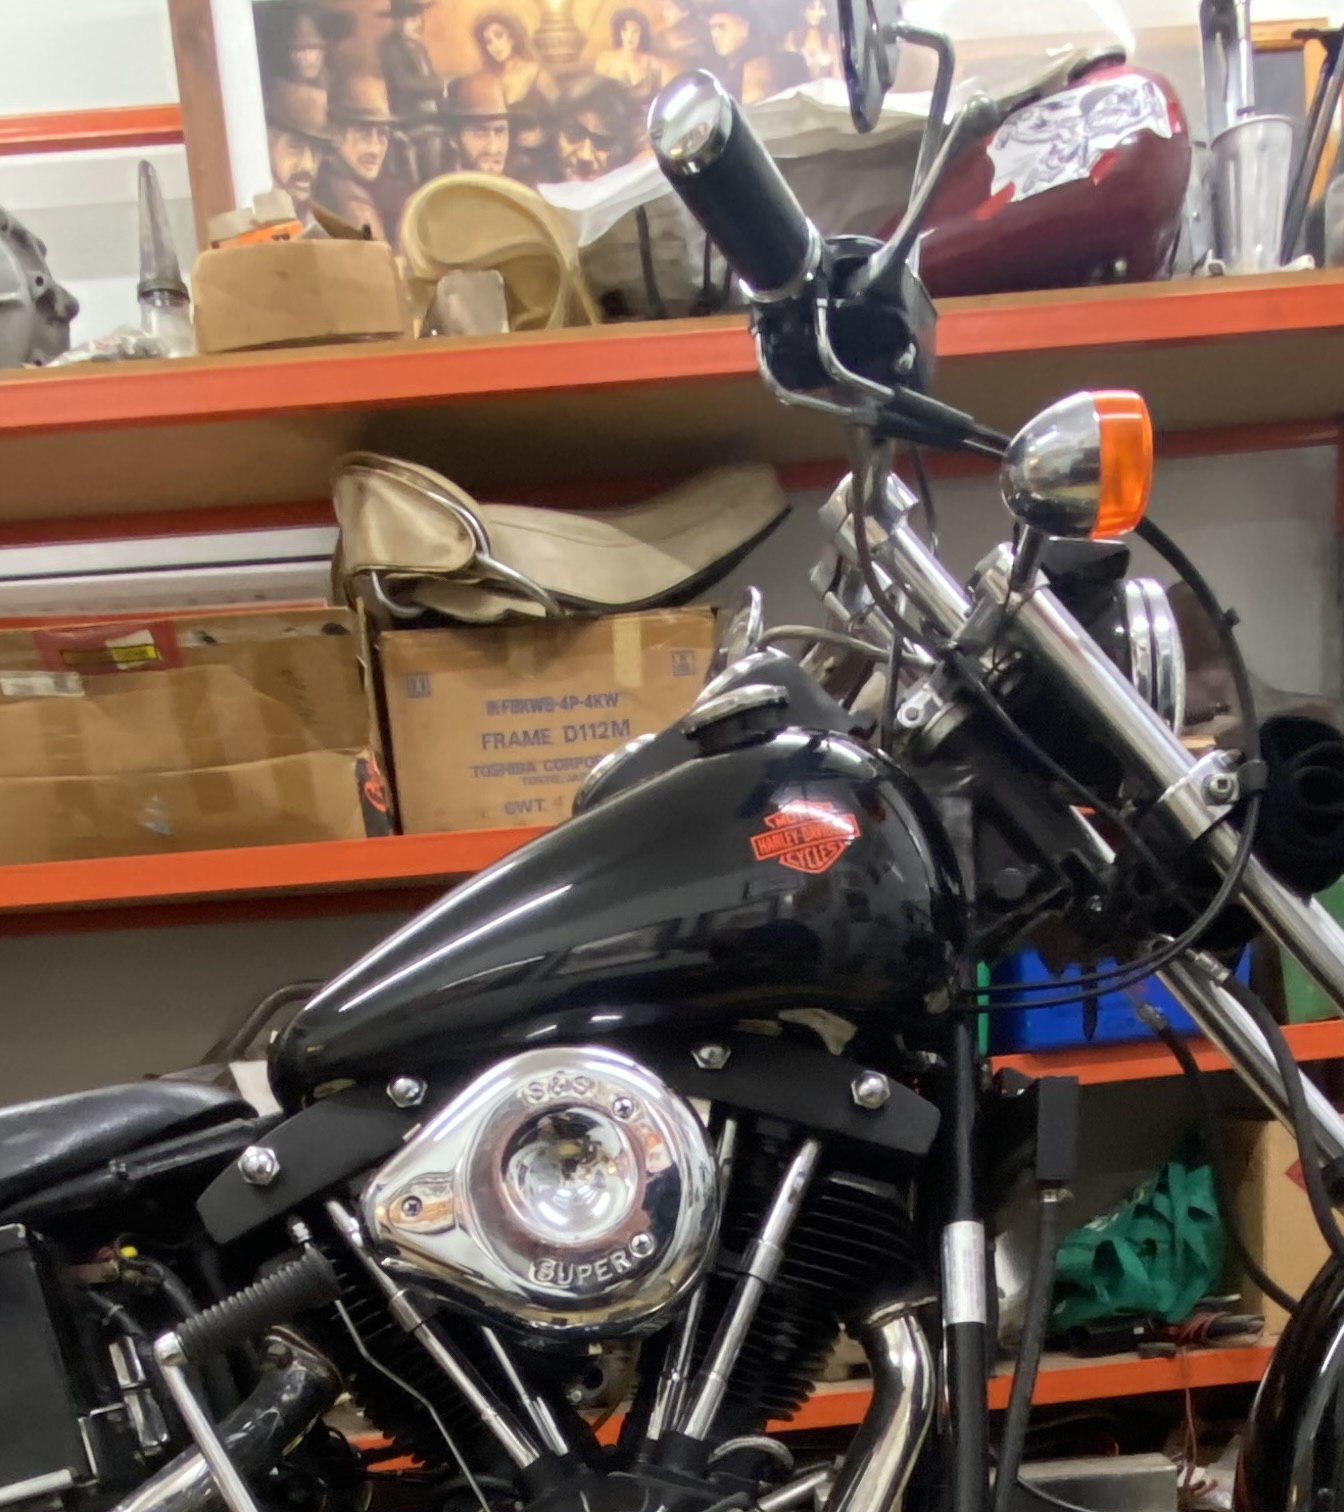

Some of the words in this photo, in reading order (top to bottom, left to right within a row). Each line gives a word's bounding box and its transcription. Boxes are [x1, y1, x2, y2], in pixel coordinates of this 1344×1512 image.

[481, 728, 553, 750] FRAME
[562, 718, 631, 743] D112M
[757, 818, 853, 857] HARLEY-DAVID
[784, 842, 838, 870] CYCLES
[526, 1071, 594, 1103] S&S
[529, 1249, 634, 1289] SUPER
